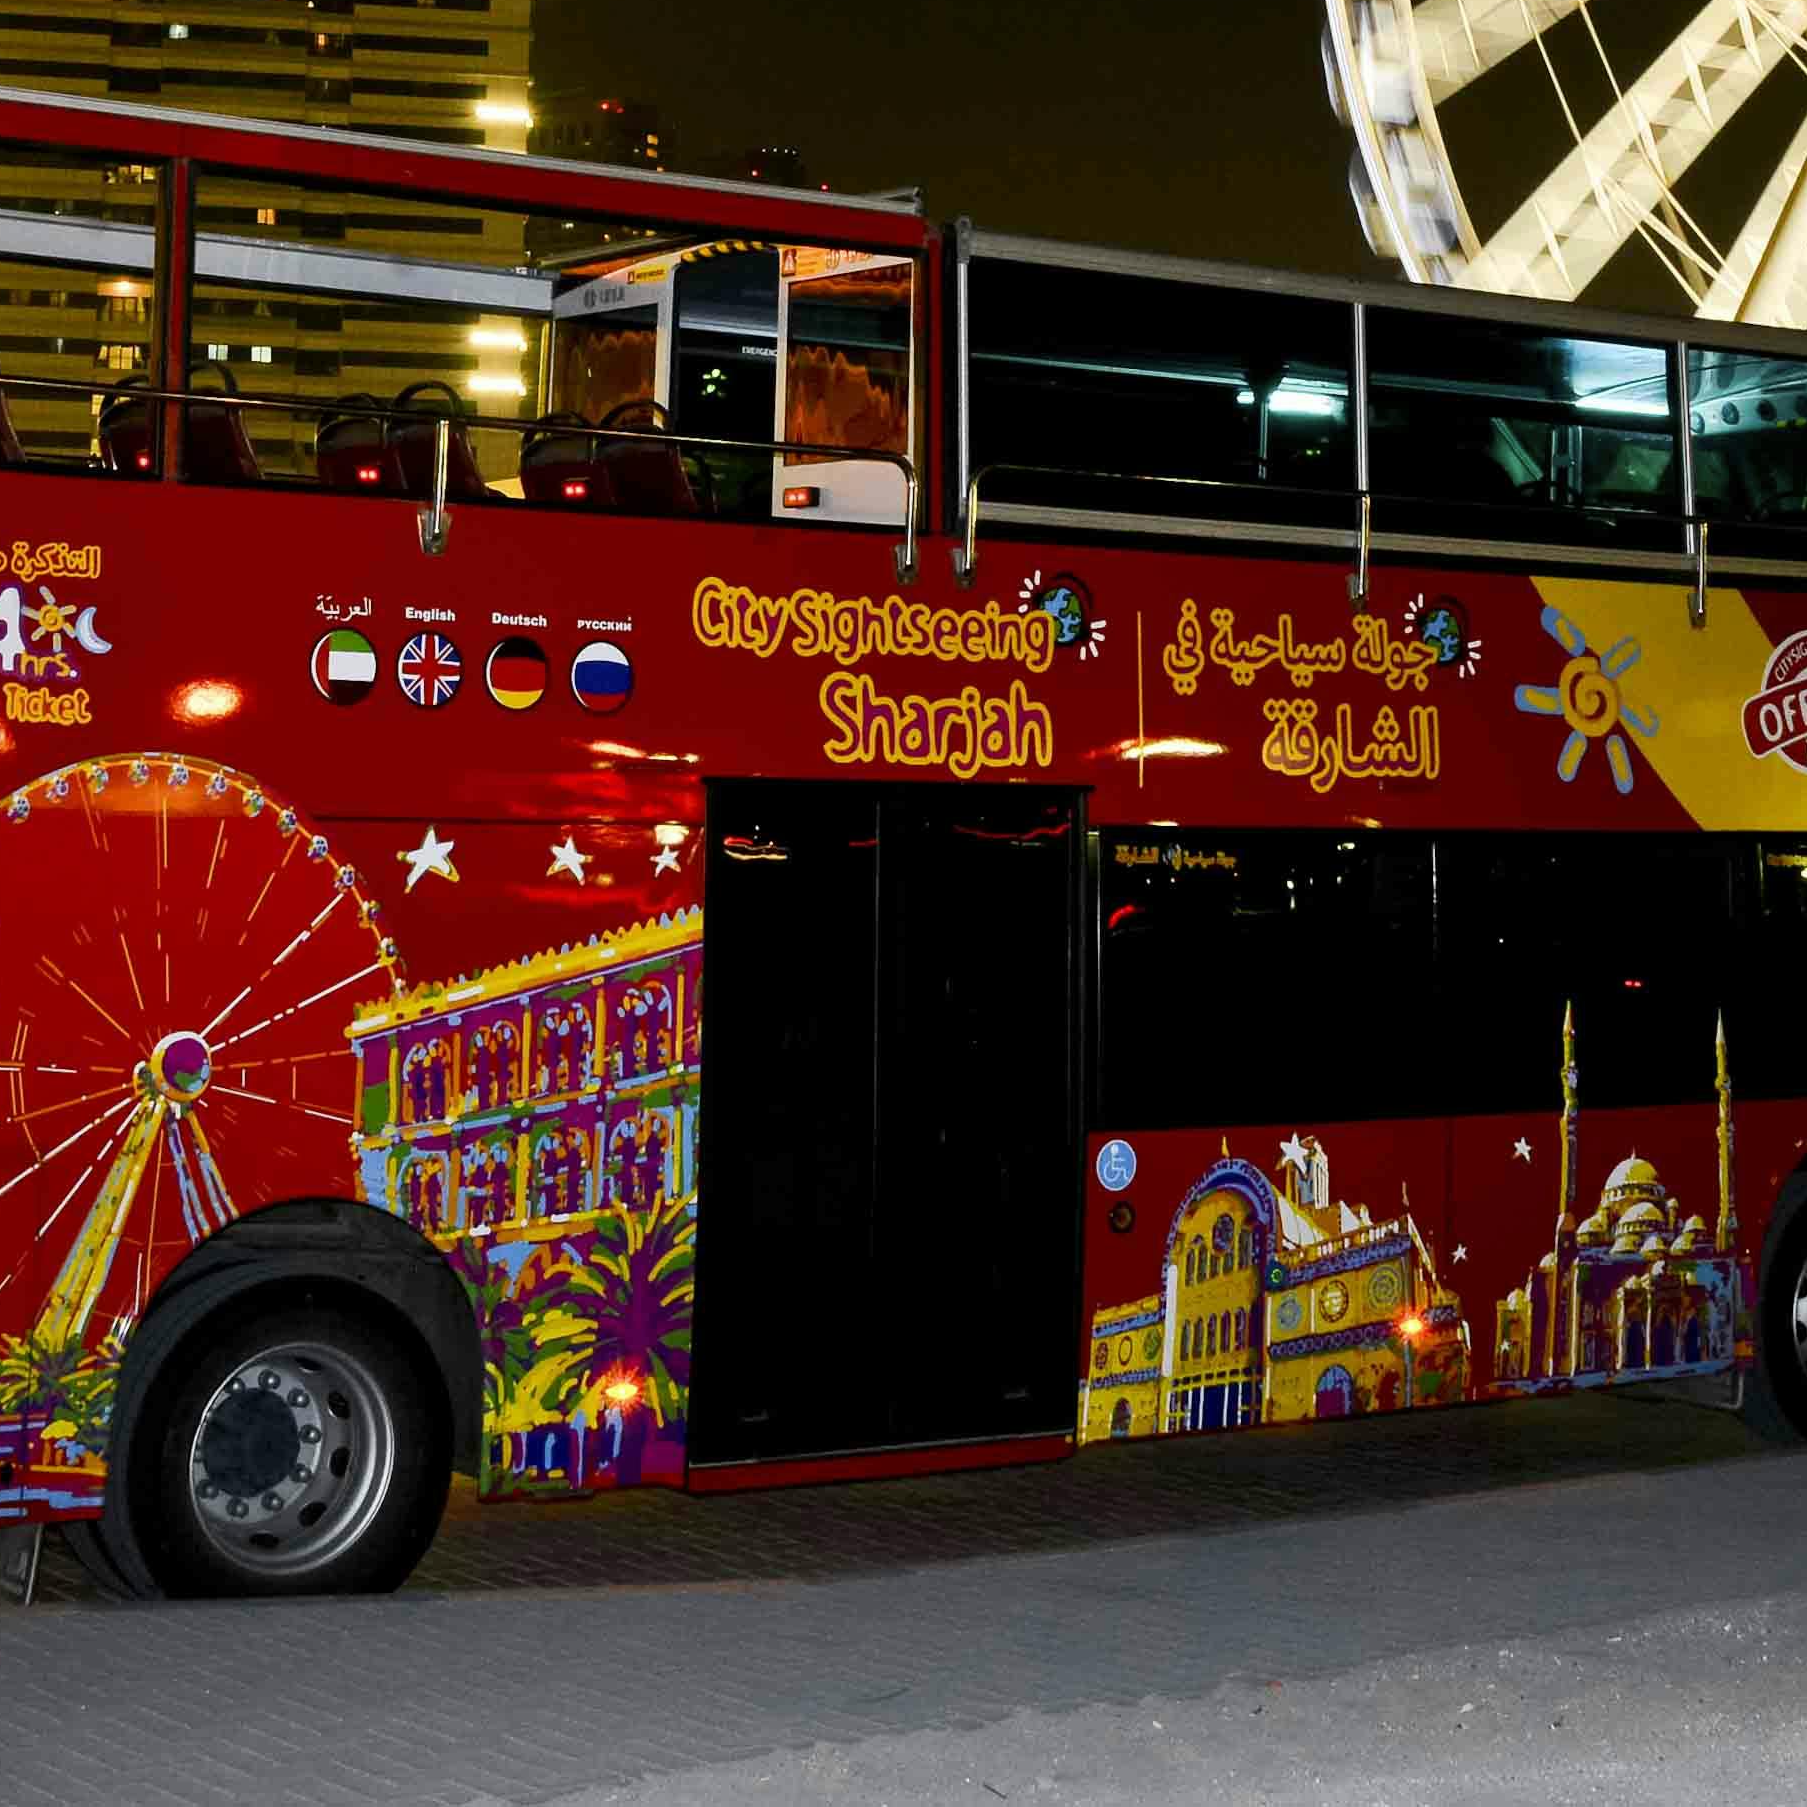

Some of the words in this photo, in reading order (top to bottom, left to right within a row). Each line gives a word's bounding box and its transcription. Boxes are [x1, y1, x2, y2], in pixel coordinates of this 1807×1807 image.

[11, 541, 101, 582] التذكرة
[405, 607, 456, 622] English
[492, 612, 548, 628] Deutsch
[1163, 598, 1205, 696] في
[1210, 607, 1346, 688] سياحية
[1352, 614, 1441, 691] جولة
[3, 682, 92, 725] Ticket
[819, 671, 1054, 779] Sharjah
[1262, 698, 1440, 793] الشارقة
